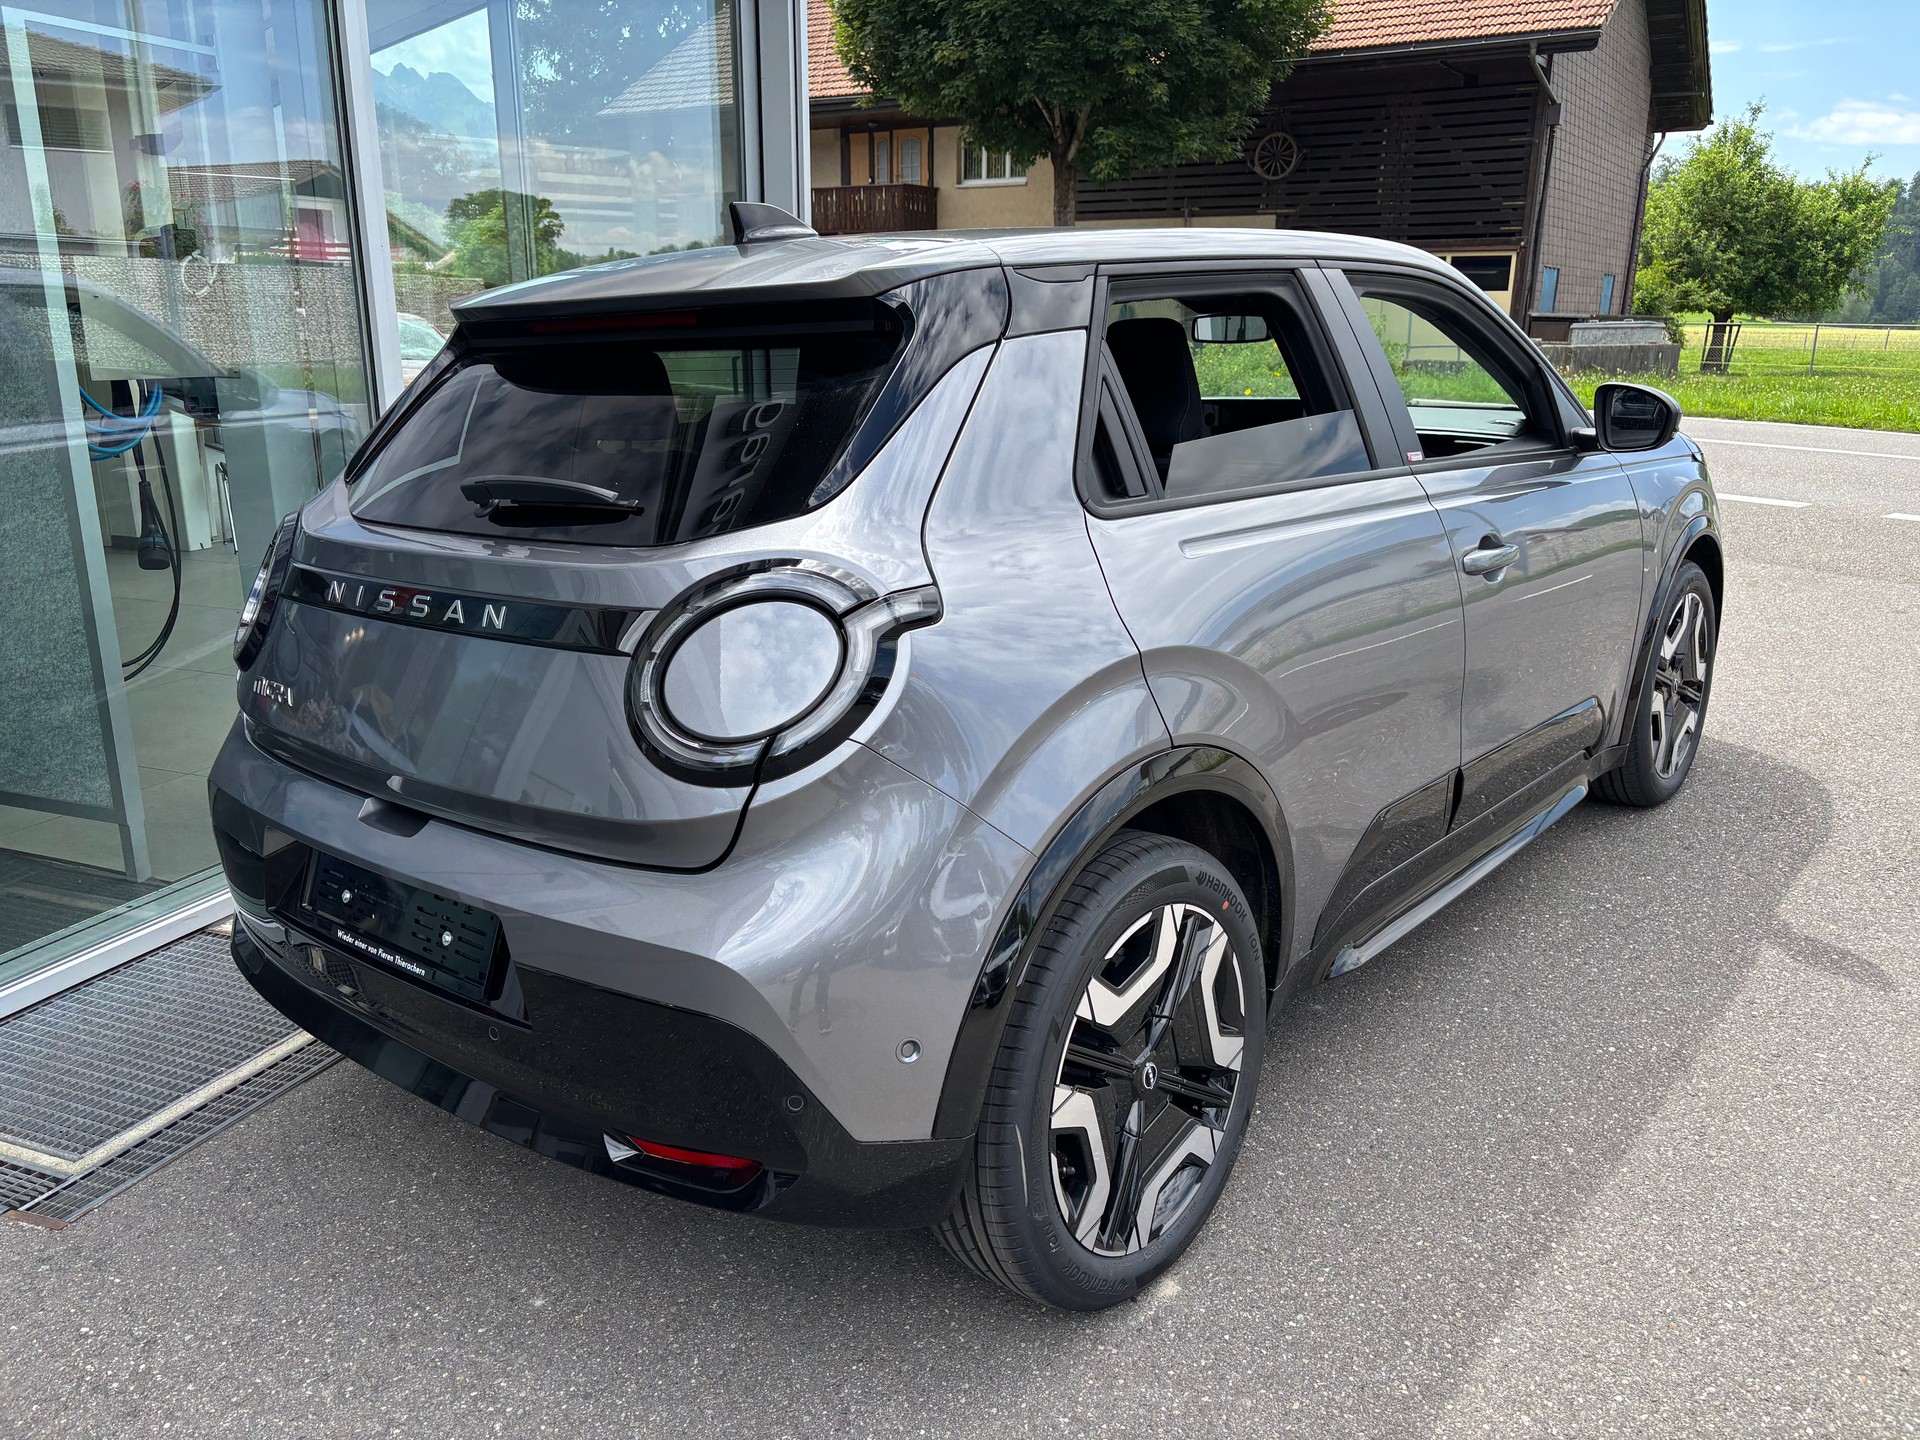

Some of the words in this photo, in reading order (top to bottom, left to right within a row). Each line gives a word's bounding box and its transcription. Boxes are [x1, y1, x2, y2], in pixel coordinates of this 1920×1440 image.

[327, 579, 509, 631] NISSAN
[337, 929, 355, 943] Wieder
[354, 939, 368, 949] einer
[368, 946, 377, 954] von
[377, 948, 393, 962] Pieren
